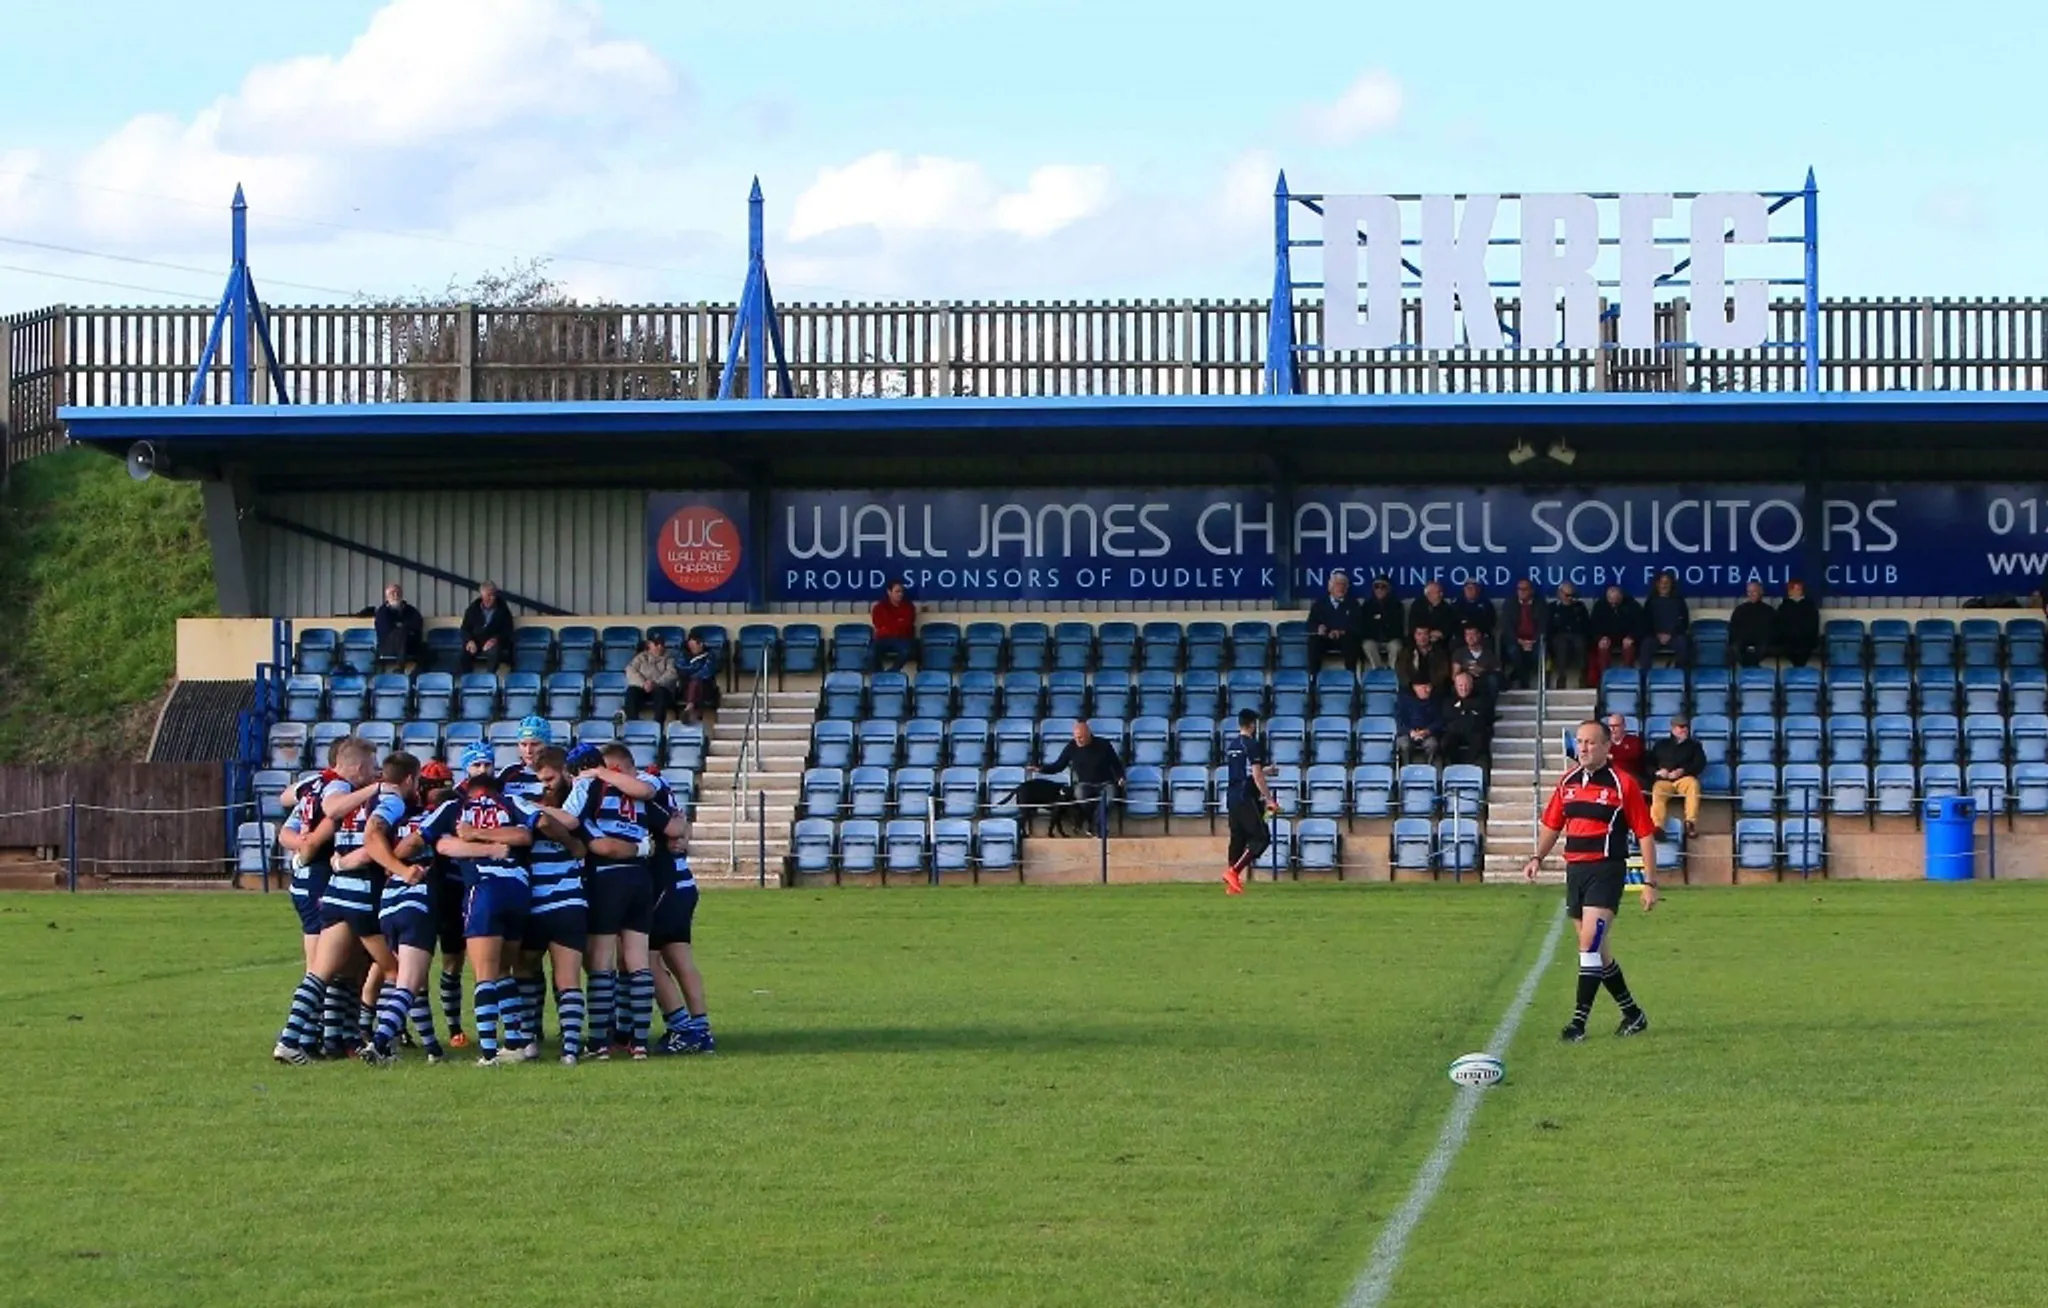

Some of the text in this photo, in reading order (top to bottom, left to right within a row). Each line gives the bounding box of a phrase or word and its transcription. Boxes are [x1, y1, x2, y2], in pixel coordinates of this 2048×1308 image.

[1323, 192, 1769, 349] DKRFC
[673, 517, 724, 548] WJC
[788, 500, 1897, 559] WALL JAMES CHAPPELL SOLICITORS
[1988, 498, 2048, 535] 01
[787, 569, 886, 589] PROUD
[903, 568, 1059, 588] SPONSORS
[1076, 568, 1111, 588] OF
[1130, 567, 1243, 587] DUDLEY
[1529, 565, 1626, 586] RUGBY
[1825, 565, 1898, 584] CLUB
